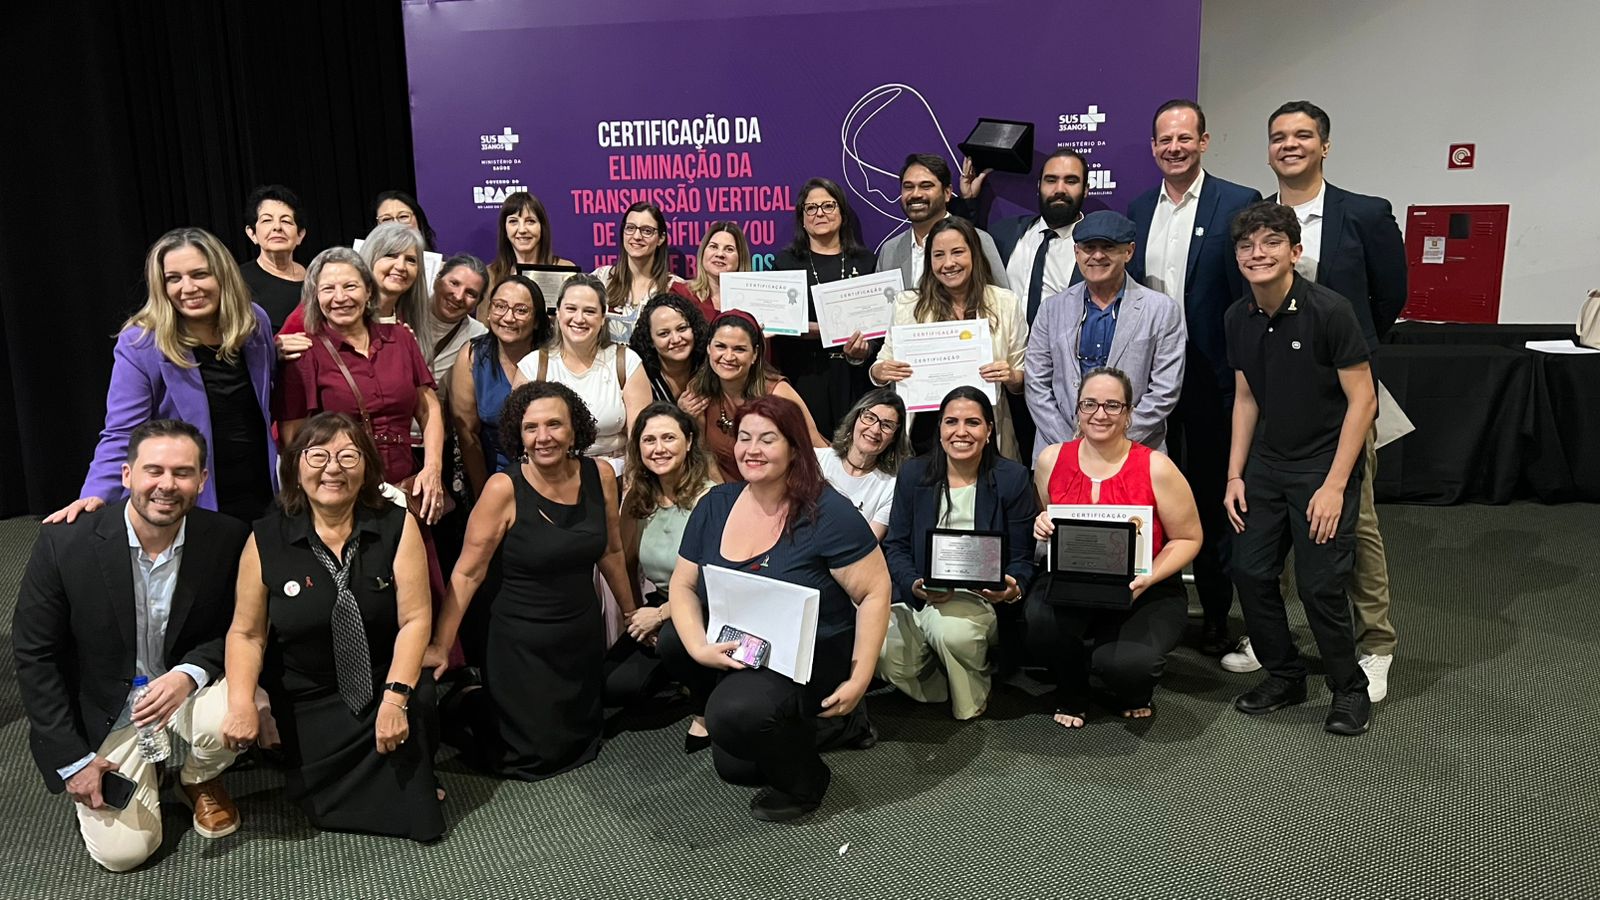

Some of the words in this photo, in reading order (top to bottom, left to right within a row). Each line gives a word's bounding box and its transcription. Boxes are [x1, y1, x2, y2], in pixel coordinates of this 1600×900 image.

[598, 113, 730, 149] CERTIFICAÇÃO
[735, 117, 762, 143] DA
[1059, 114, 1079, 124] SUS
[480, 135, 496, 143] SUS
[609, 148, 721, 183] ELIMINAÇÃO
[727, 152, 752, 178] DA
[705, 185, 796, 213] VERTICAL
[593, 222, 617, 247] DE
